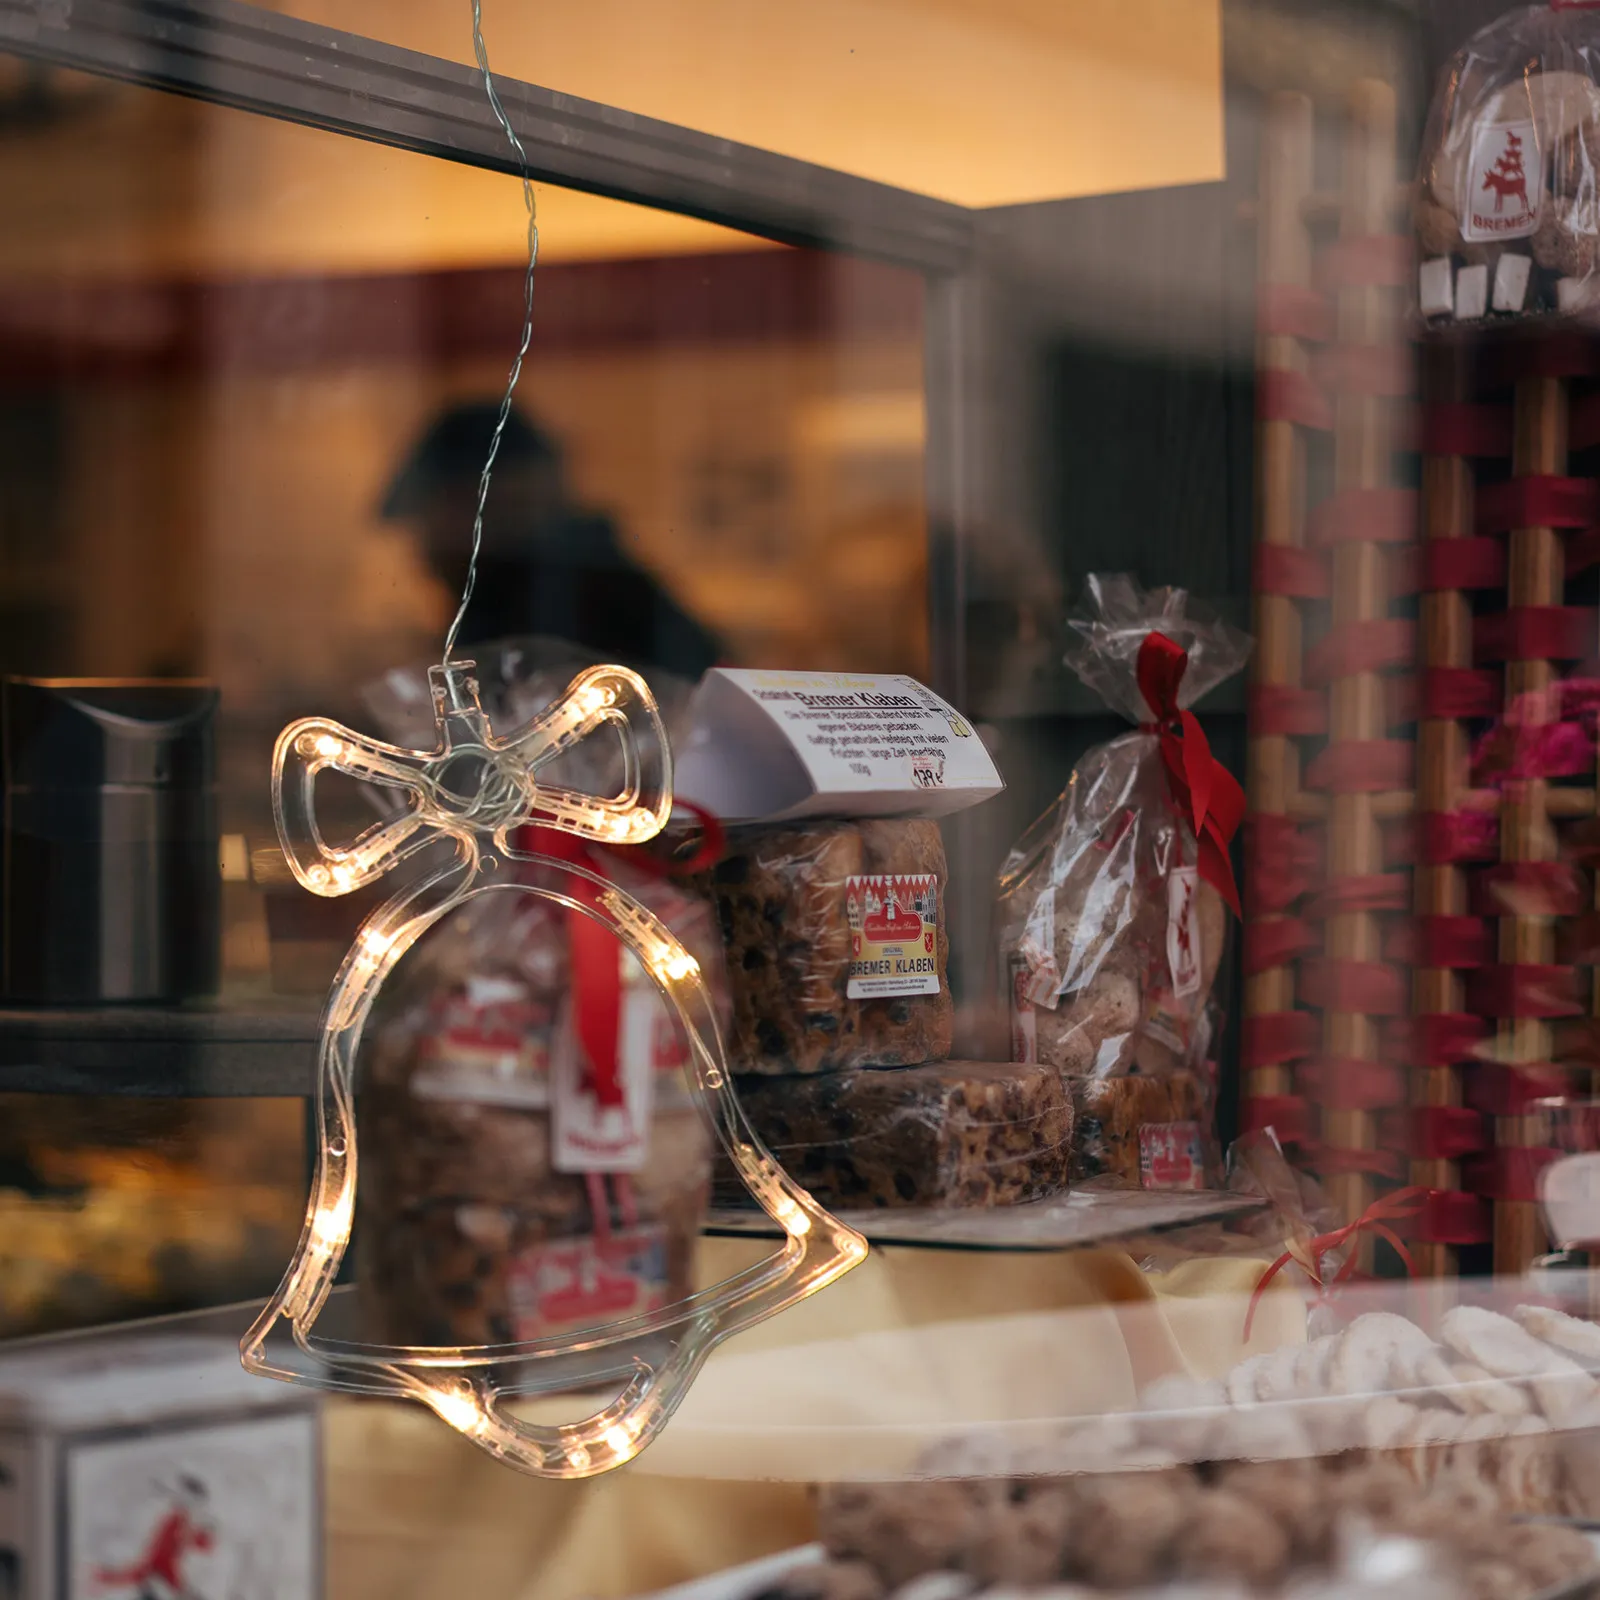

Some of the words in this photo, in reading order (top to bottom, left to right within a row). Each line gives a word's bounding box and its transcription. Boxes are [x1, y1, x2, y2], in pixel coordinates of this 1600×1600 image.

[1473, 207, 1536, 231] BREMEN
[794, 692, 859, 706] Bremer
[855, 692, 918, 706] Klaben
[900, 710, 924, 719] frisch
[880, 735, 915, 746] Hefeteig
[911, 735, 927, 744] mit
[925, 735, 949, 744] vielen
[890, 747, 907, 758] Zeit
[850, 959, 891, 976] BREMER
[896, 958, 935, 973] KLABEN
